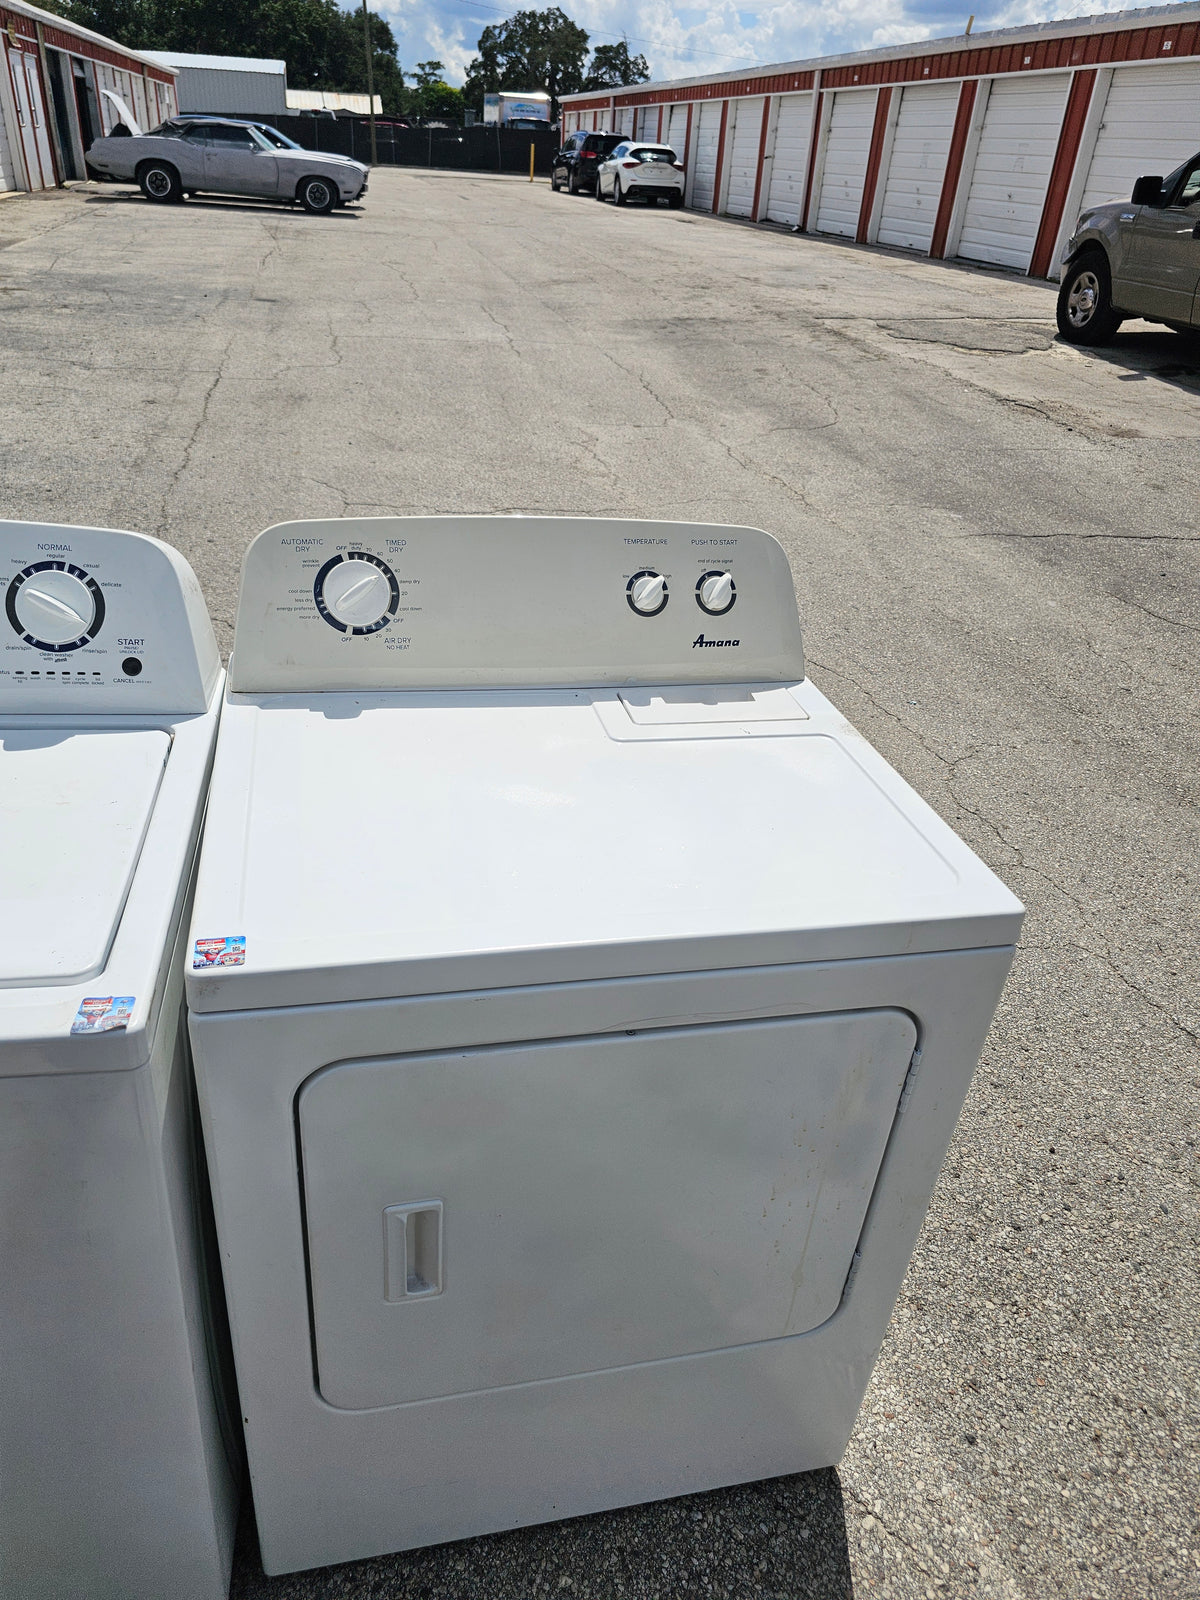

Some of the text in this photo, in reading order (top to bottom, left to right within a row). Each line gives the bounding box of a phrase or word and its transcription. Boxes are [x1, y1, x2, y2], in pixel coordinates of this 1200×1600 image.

[281, 538, 324, 546] AUTOMATIC
[38, 544, 72, 552] NORMAL
[692, 634, 740, 648] Amana
